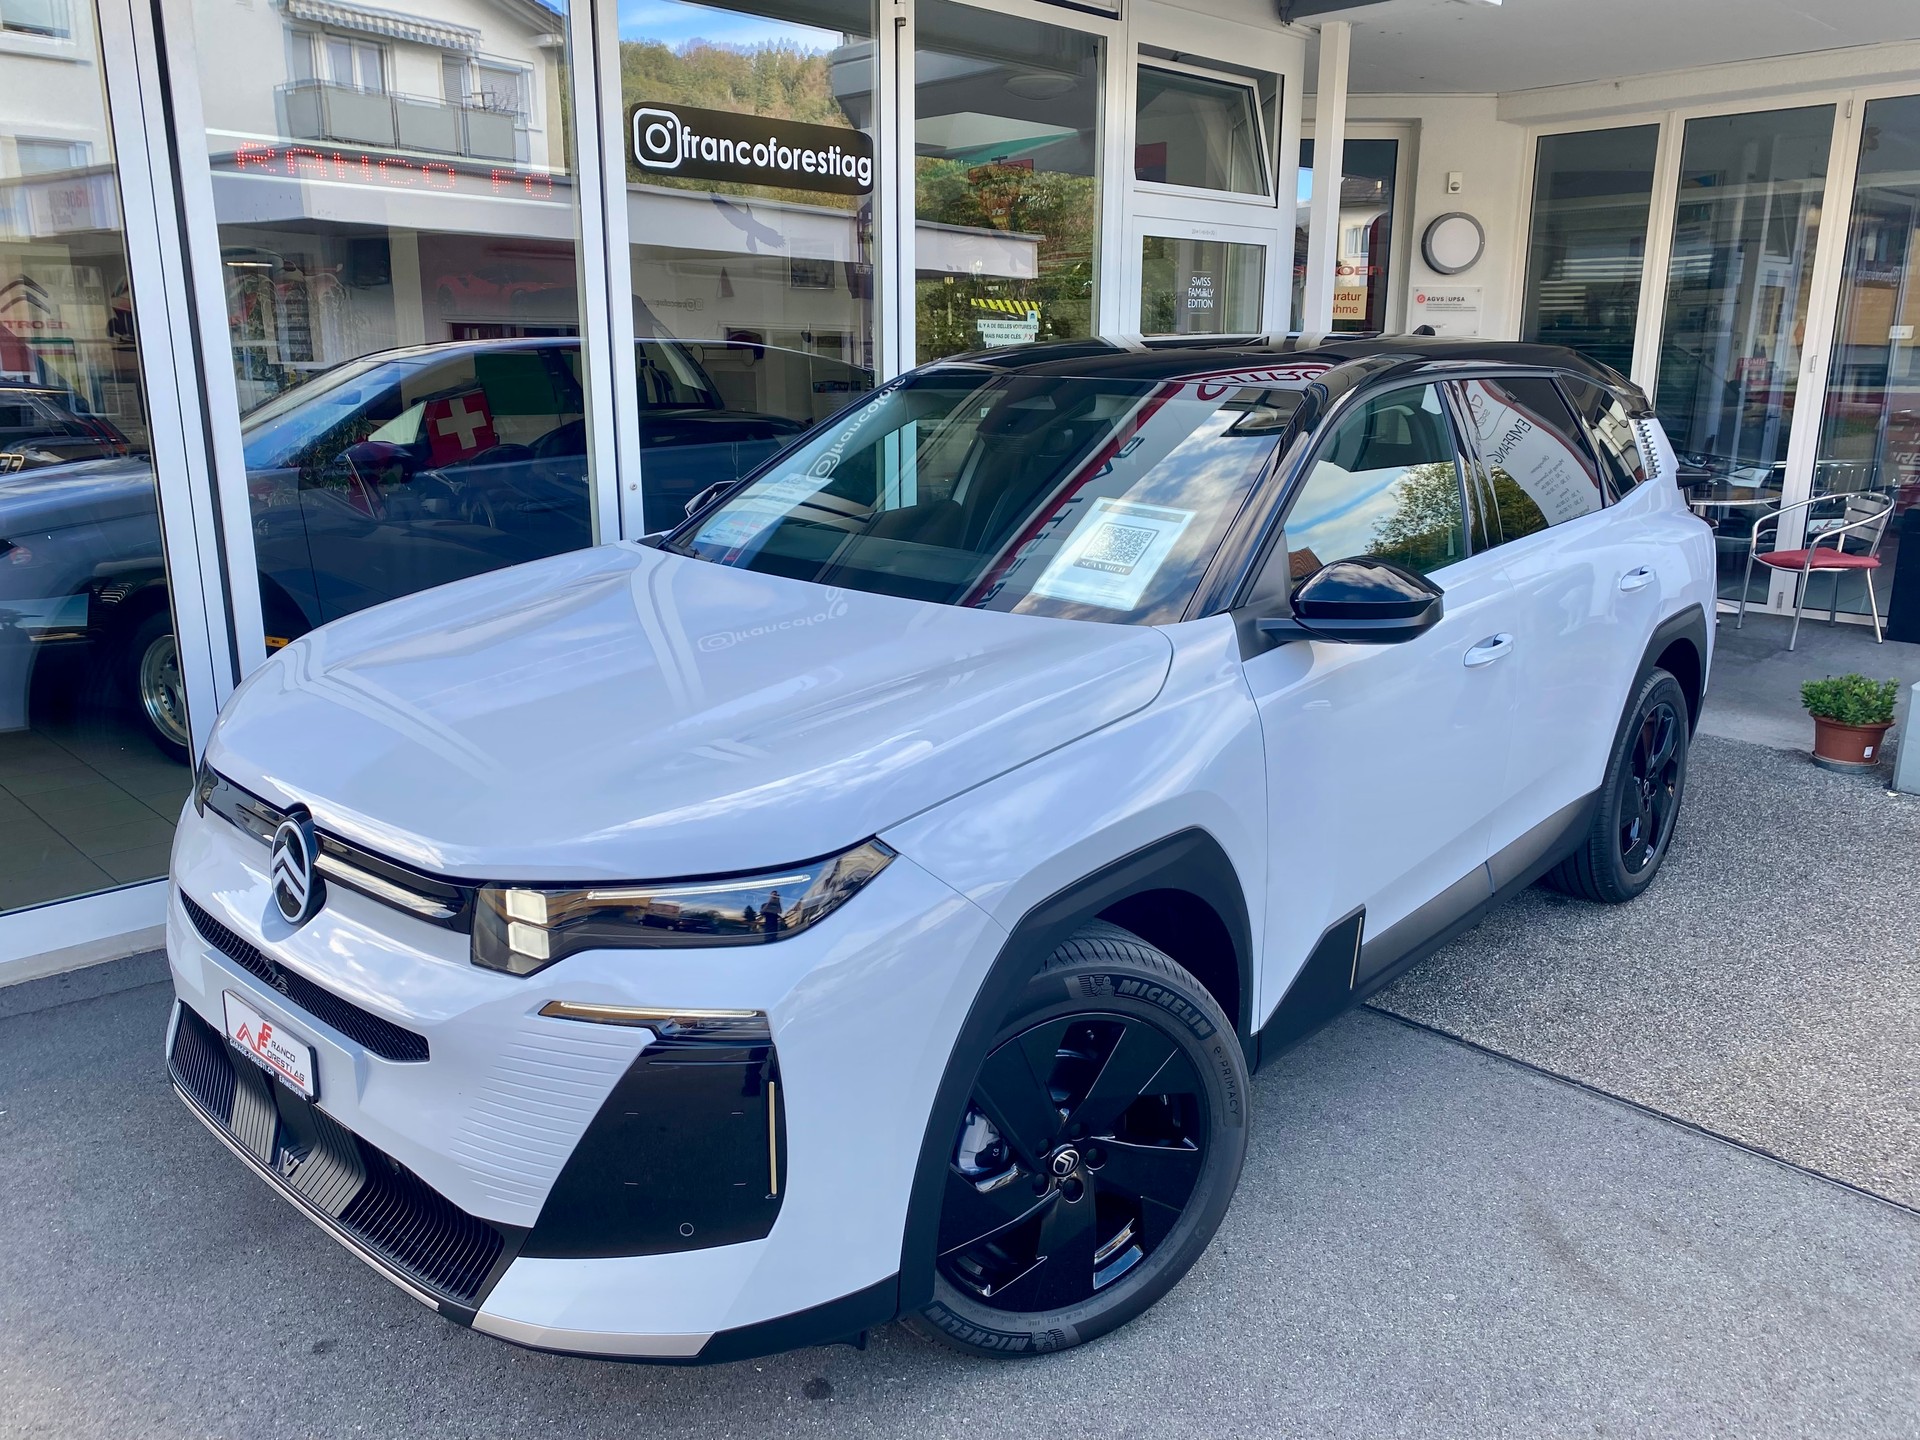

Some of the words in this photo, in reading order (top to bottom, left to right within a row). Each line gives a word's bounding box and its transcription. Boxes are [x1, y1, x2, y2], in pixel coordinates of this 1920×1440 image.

[682, 126, 872, 187] francoforestiag
[1187, 299, 1214, 308] EDITION
[1191, 277, 1212, 287] SWISS
[1117, 979, 1212, 1038] MICHELIN
[924, 1305, 1031, 1352] MICHELIN
